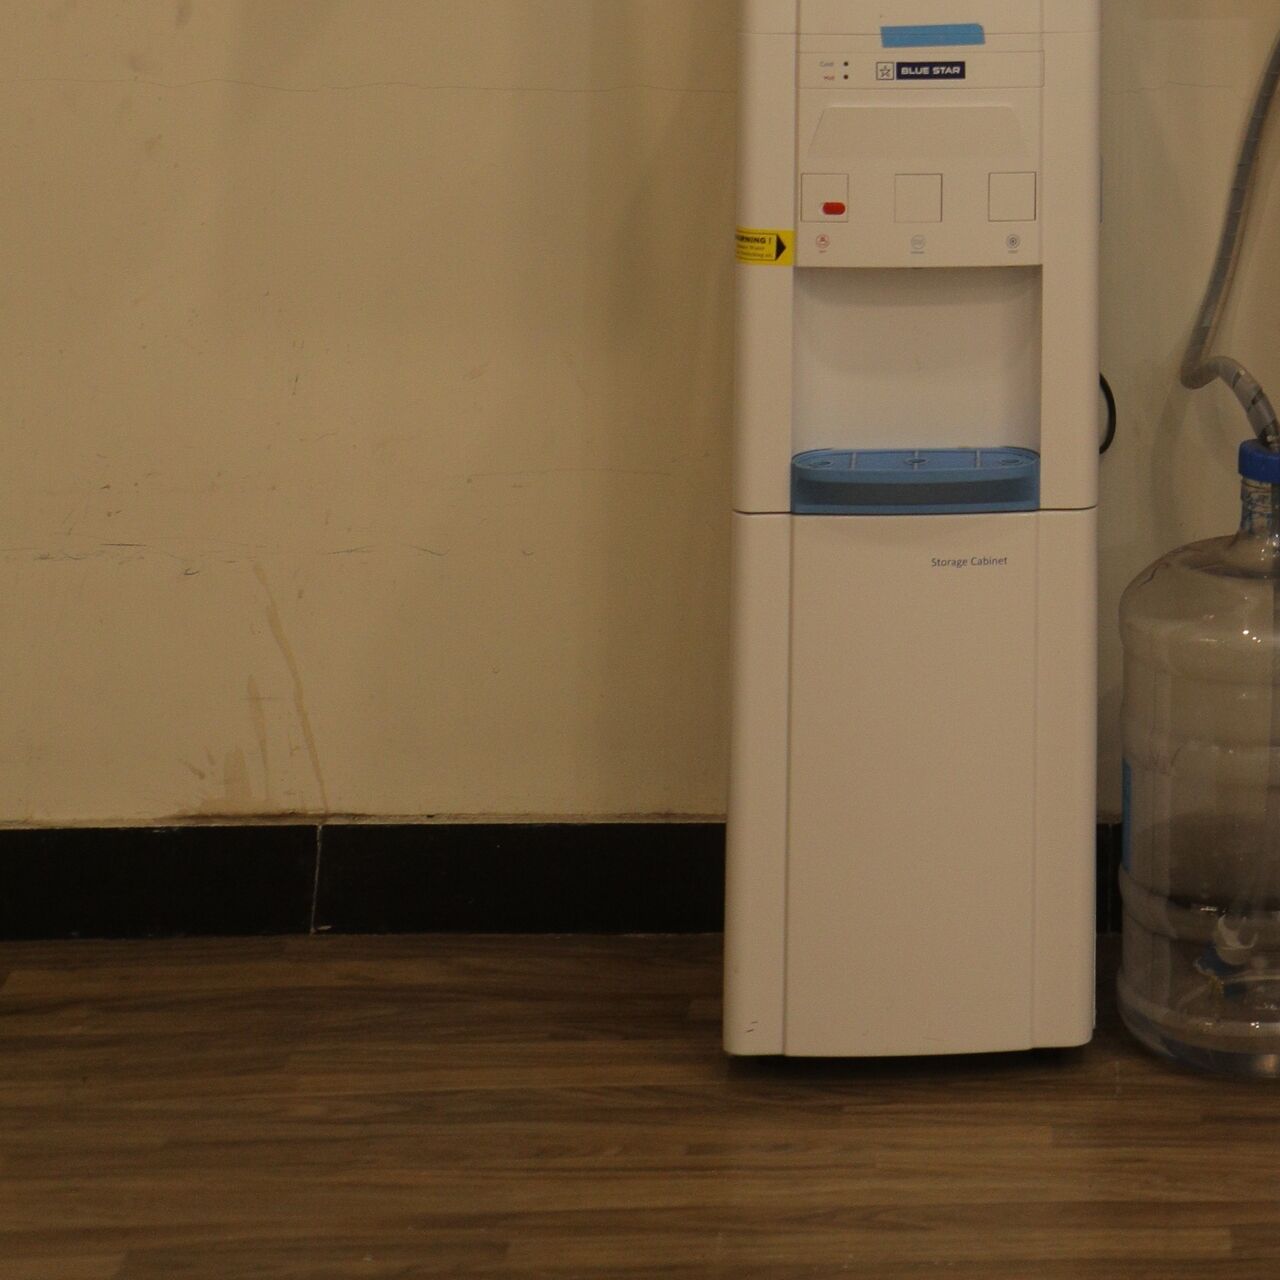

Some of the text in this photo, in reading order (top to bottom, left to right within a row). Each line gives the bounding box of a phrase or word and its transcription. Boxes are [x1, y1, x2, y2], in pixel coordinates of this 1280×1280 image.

[901, 66, 961, 75] BLUE STAR
[931, 556, 1007, 568] Storage Cabinet
